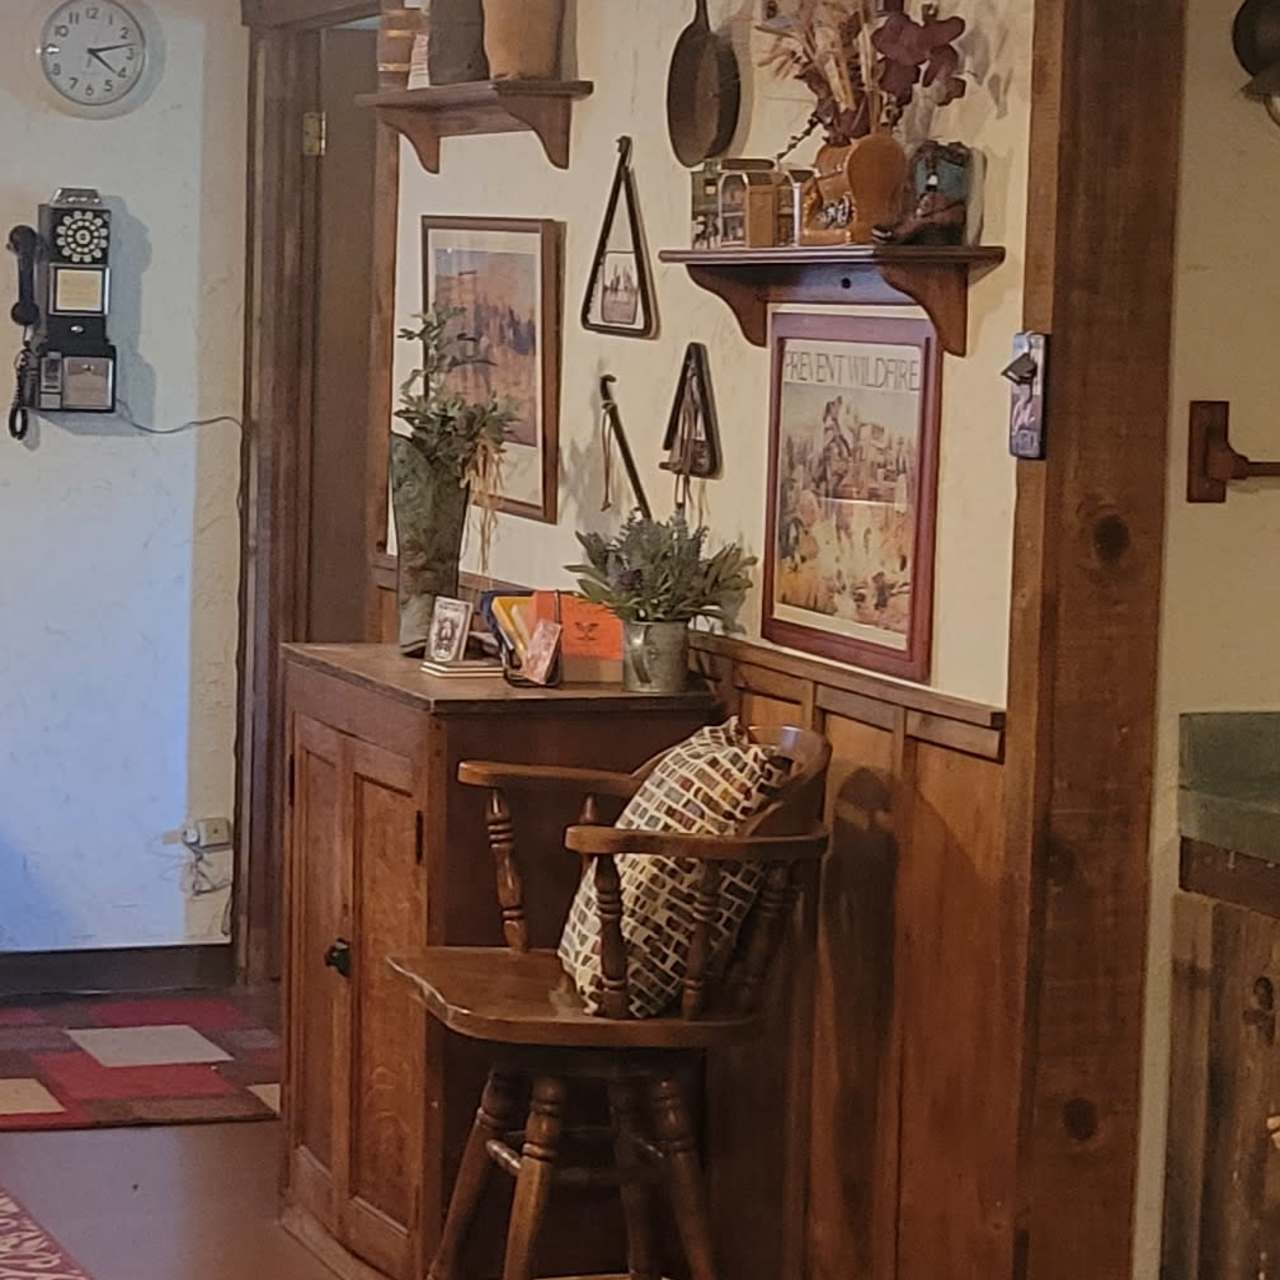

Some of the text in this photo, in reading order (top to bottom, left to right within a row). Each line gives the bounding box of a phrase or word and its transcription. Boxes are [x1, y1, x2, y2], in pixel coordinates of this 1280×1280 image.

[68, 11, 80, 25] 11
[85, 7, 99, 19] 12
[54, 24, 69, 38] 10
[120, 26, 129, 40] 2
[52, 62, 61, 76] 8
[68, 76, 79, 90] 7
[84, 83, 94, 97] 6
[104, 79, 113, 93] 5
[784, 350, 921, 391] PREVENT WILDFIRE
